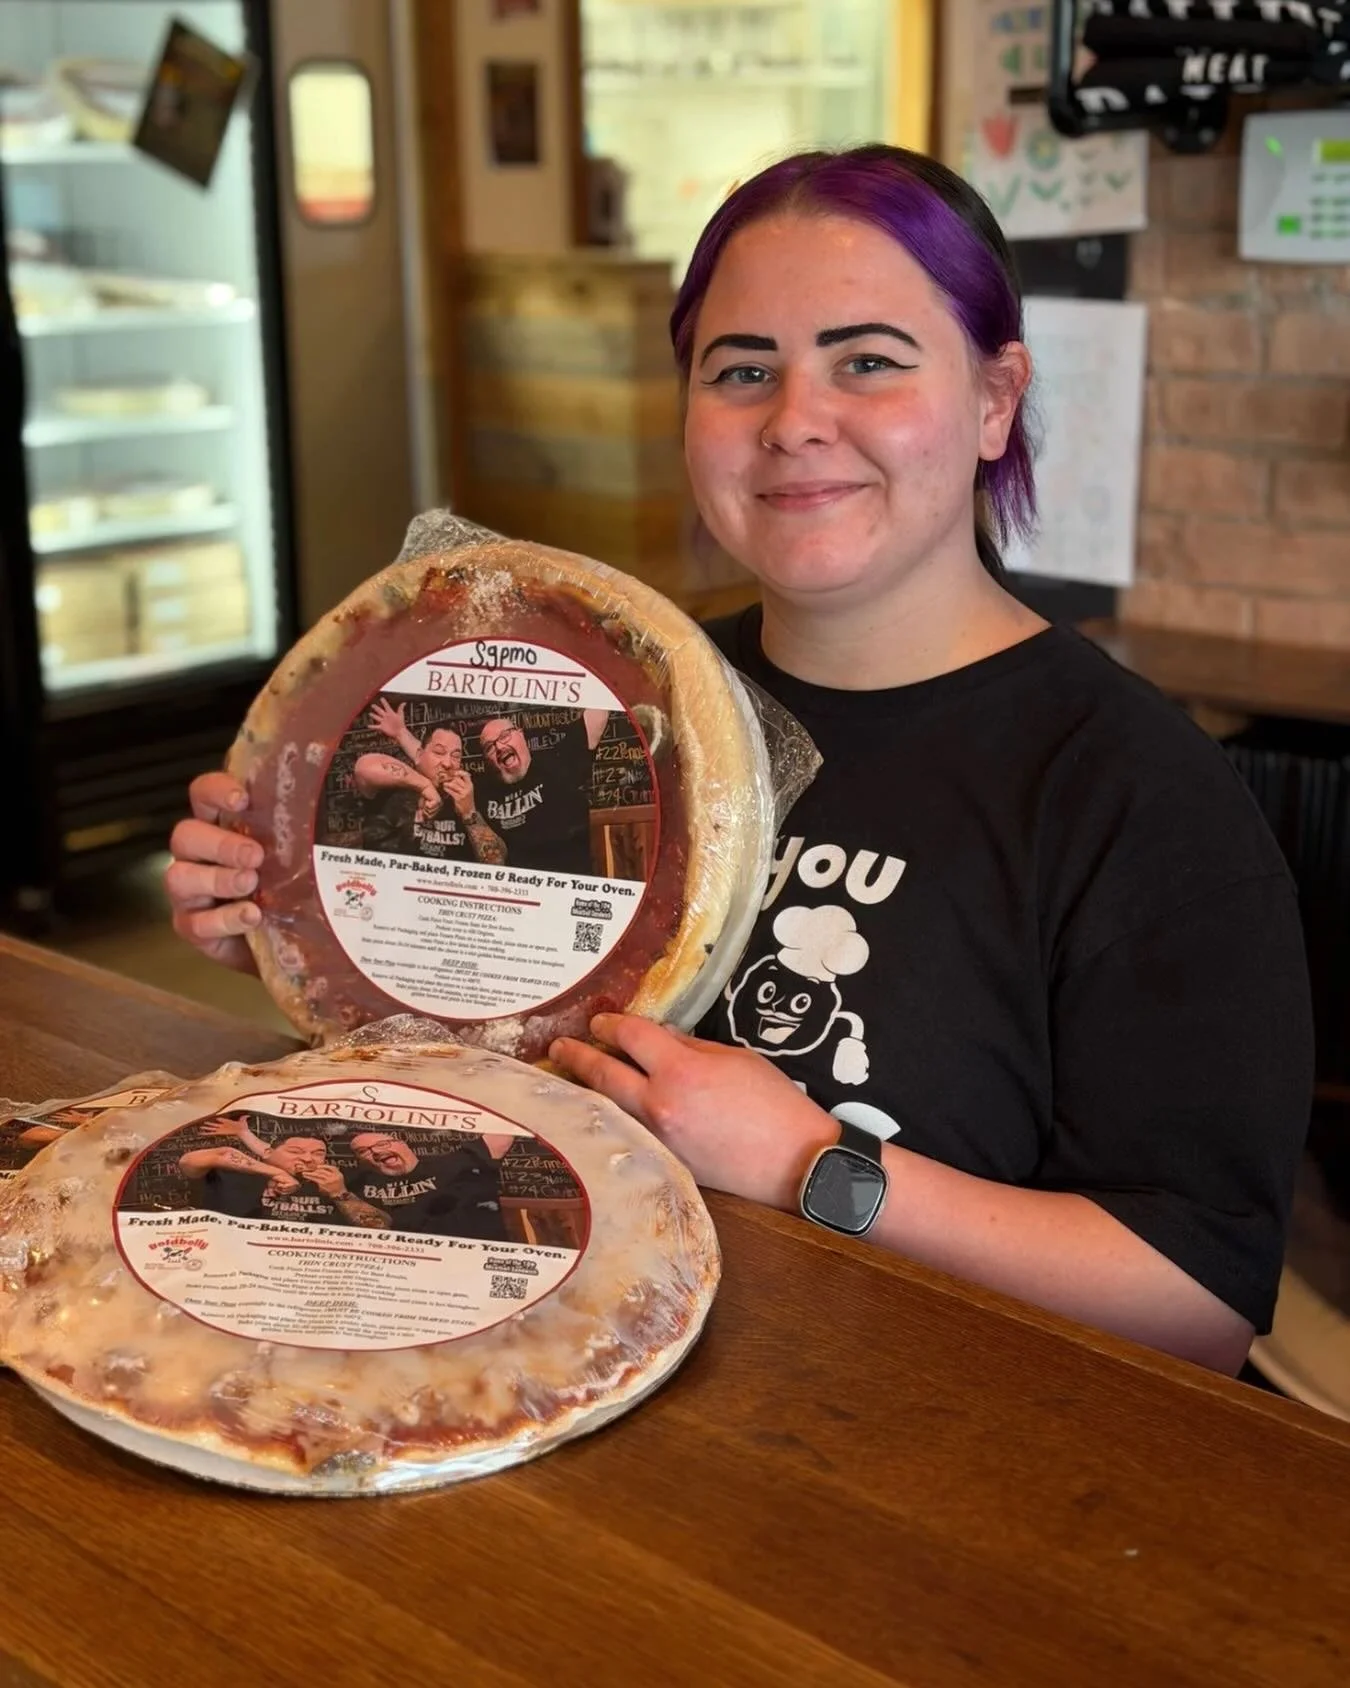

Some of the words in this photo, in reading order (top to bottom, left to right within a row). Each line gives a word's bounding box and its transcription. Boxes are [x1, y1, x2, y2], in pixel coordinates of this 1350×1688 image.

[427, 670, 581, 703] BARTOLINI'S
[320, 851, 353, 864] Fresh
[354, 855, 387, 869] Made,
[389, 859, 450, 876] Par-Baked,
[453, 866, 492, 881] Frozen
[494, 871, 506, 882] &
[507, 872, 545, 887] Ready
[546, 877, 568, 889] For
[570, 879, 599, 892] Your
[602, 883, 636, 897] Oven.
[417, 895, 459, 908] COOKING
[459, 900, 522, 915] INSTRUCTIONS
[279, 1101, 477, 1130] BARTOLINI'S
[128, 1216, 173, 1227] Fresh
[177, 1214, 222, 1226] Made,
[227, 1219, 313, 1236] Par-Baked,
[318, 1228, 373, 1240] Frozen
[377, 1231, 392, 1241] &
[395, 1234, 444, 1248] Ready
[447, 1239, 477, 1251] For
[480, 1243, 519, 1255] Your
[523, 1247, 568, 1260] Oven.
[267, 1250, 326, 1260] COOKING
[328, 1252, 417, 1268] INSTRUCTIONS
